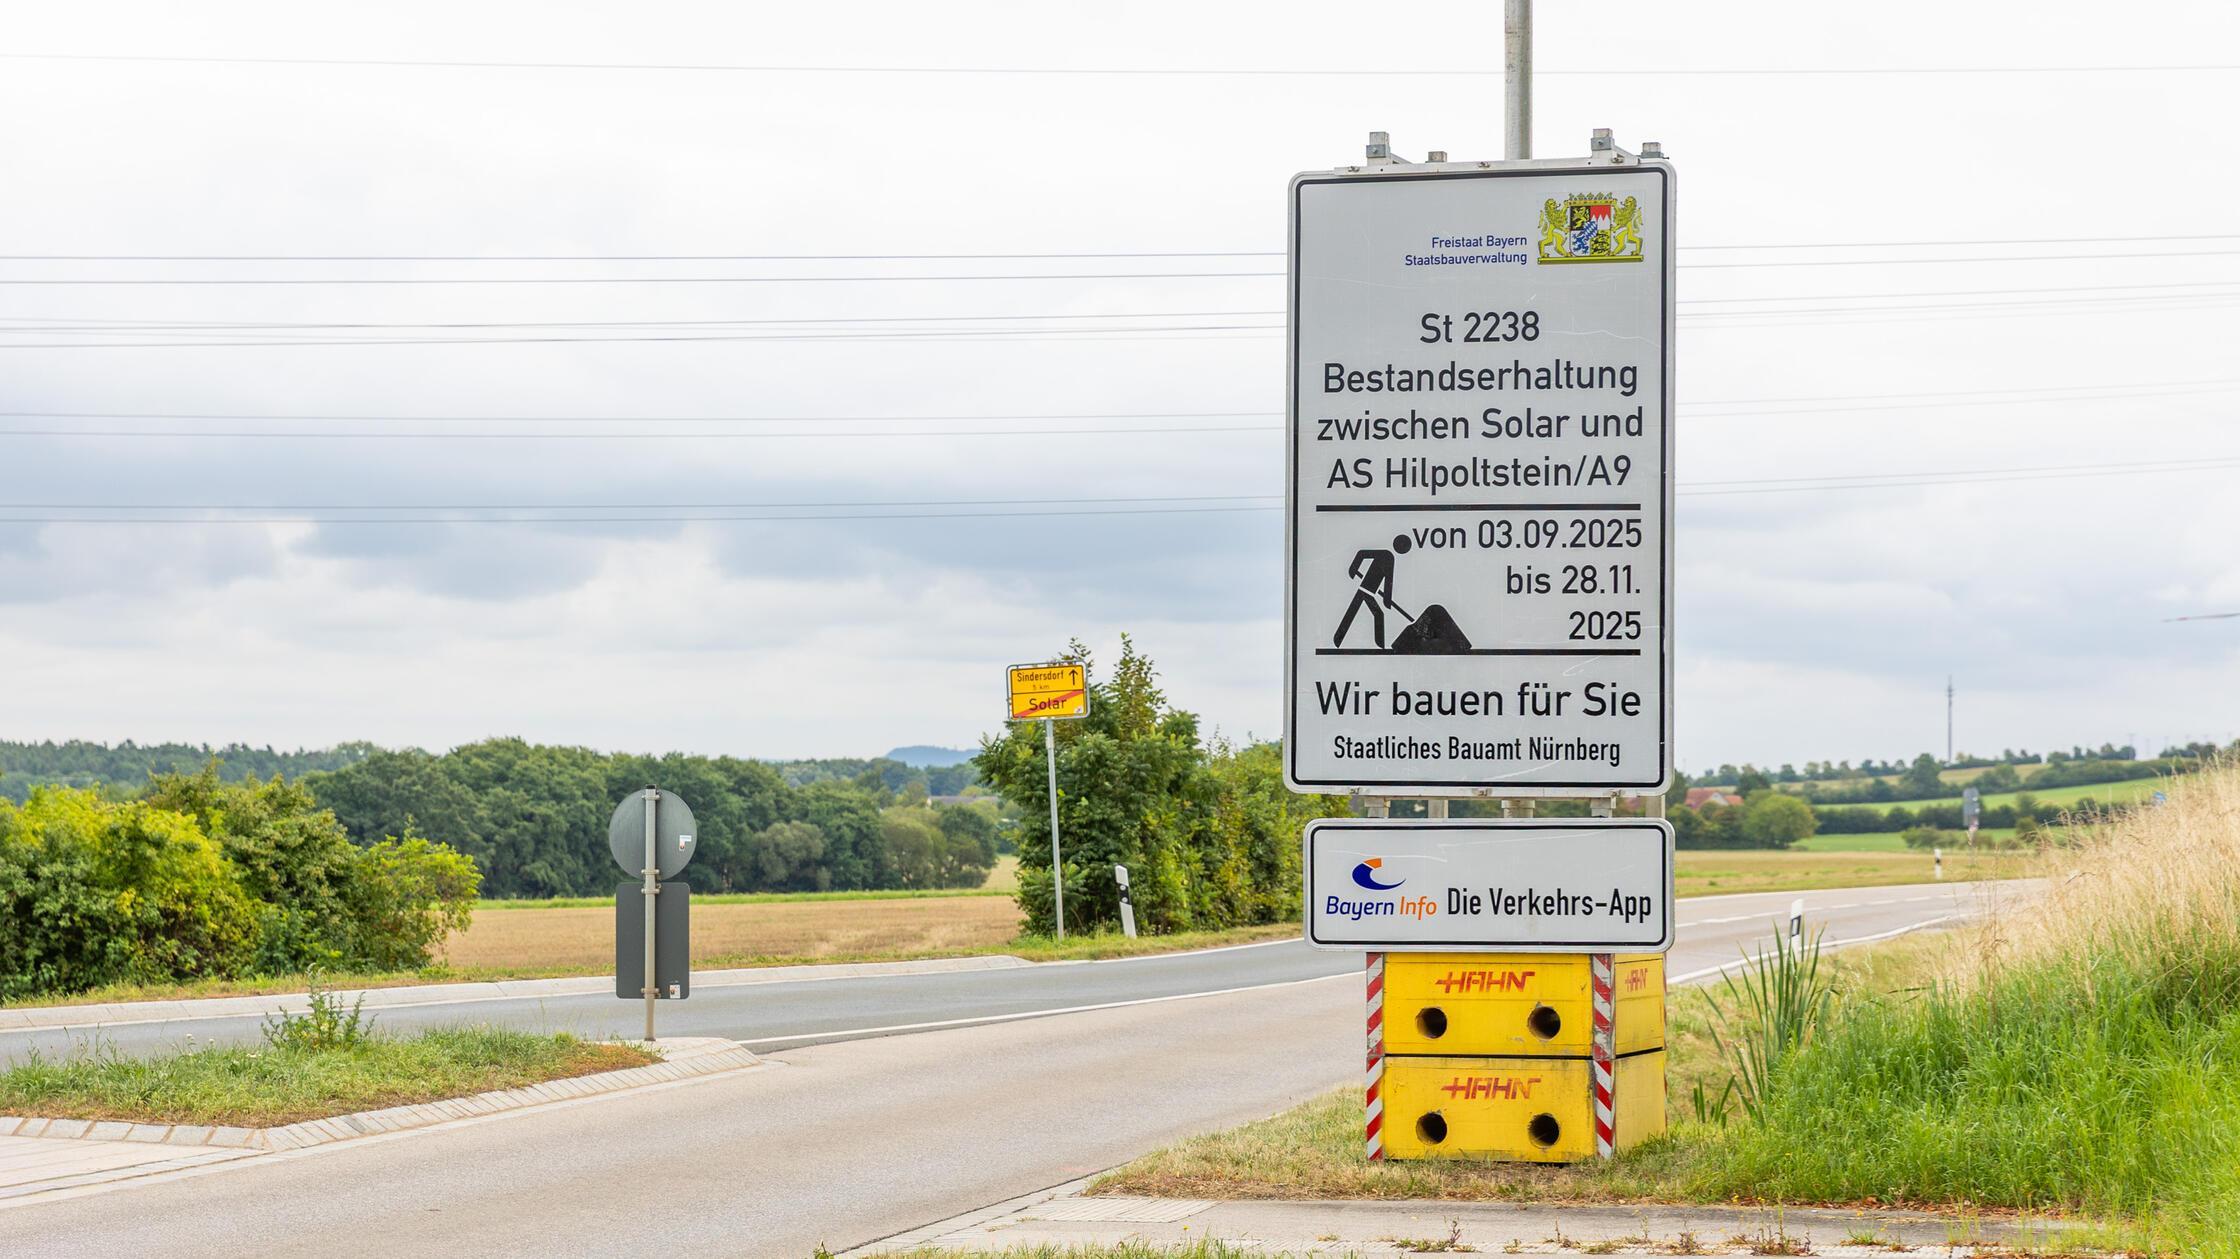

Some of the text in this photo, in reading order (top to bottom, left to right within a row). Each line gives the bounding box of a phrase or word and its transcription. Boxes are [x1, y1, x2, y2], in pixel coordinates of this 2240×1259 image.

[1432, 234, 1527, 251] Freistaat Bayern
[1405, 251, 1527, 267] Staatsbauverwaltung
[1420, 311, 1540, 344] St 2238
[1324, 360, 1638, 397] Bestandserhaltung
[1317, 406, 1643, 441] zwischen Solar und
[1327, 454, 1631, 495] AS Hilpoltstein/A9
[1412, 519, 1642, 549] von 03.09.2025
[1507, 564, 1641, 595] bis 28.11.
[1569, 611, 1641, 641] 2025
[1017, 670, 1064, 682] Sindersdorf
[1029, 698, 1067, 711] Solar
[1315, 681, 1641, 717] Wir bauen für Sie
[1333, 736, 1620, 767] Staatliches Bauamt Nürnberg
[1326, 896, 1437, 921] Bayern Info
[1448, 888, 1651, 923] Die Verkehrs-App
[1435, 971, 1535, 993] HAHN
[1624, 968, 1648, 991] HAHN
[1441, 1077, 1541, 1100] HAHN
